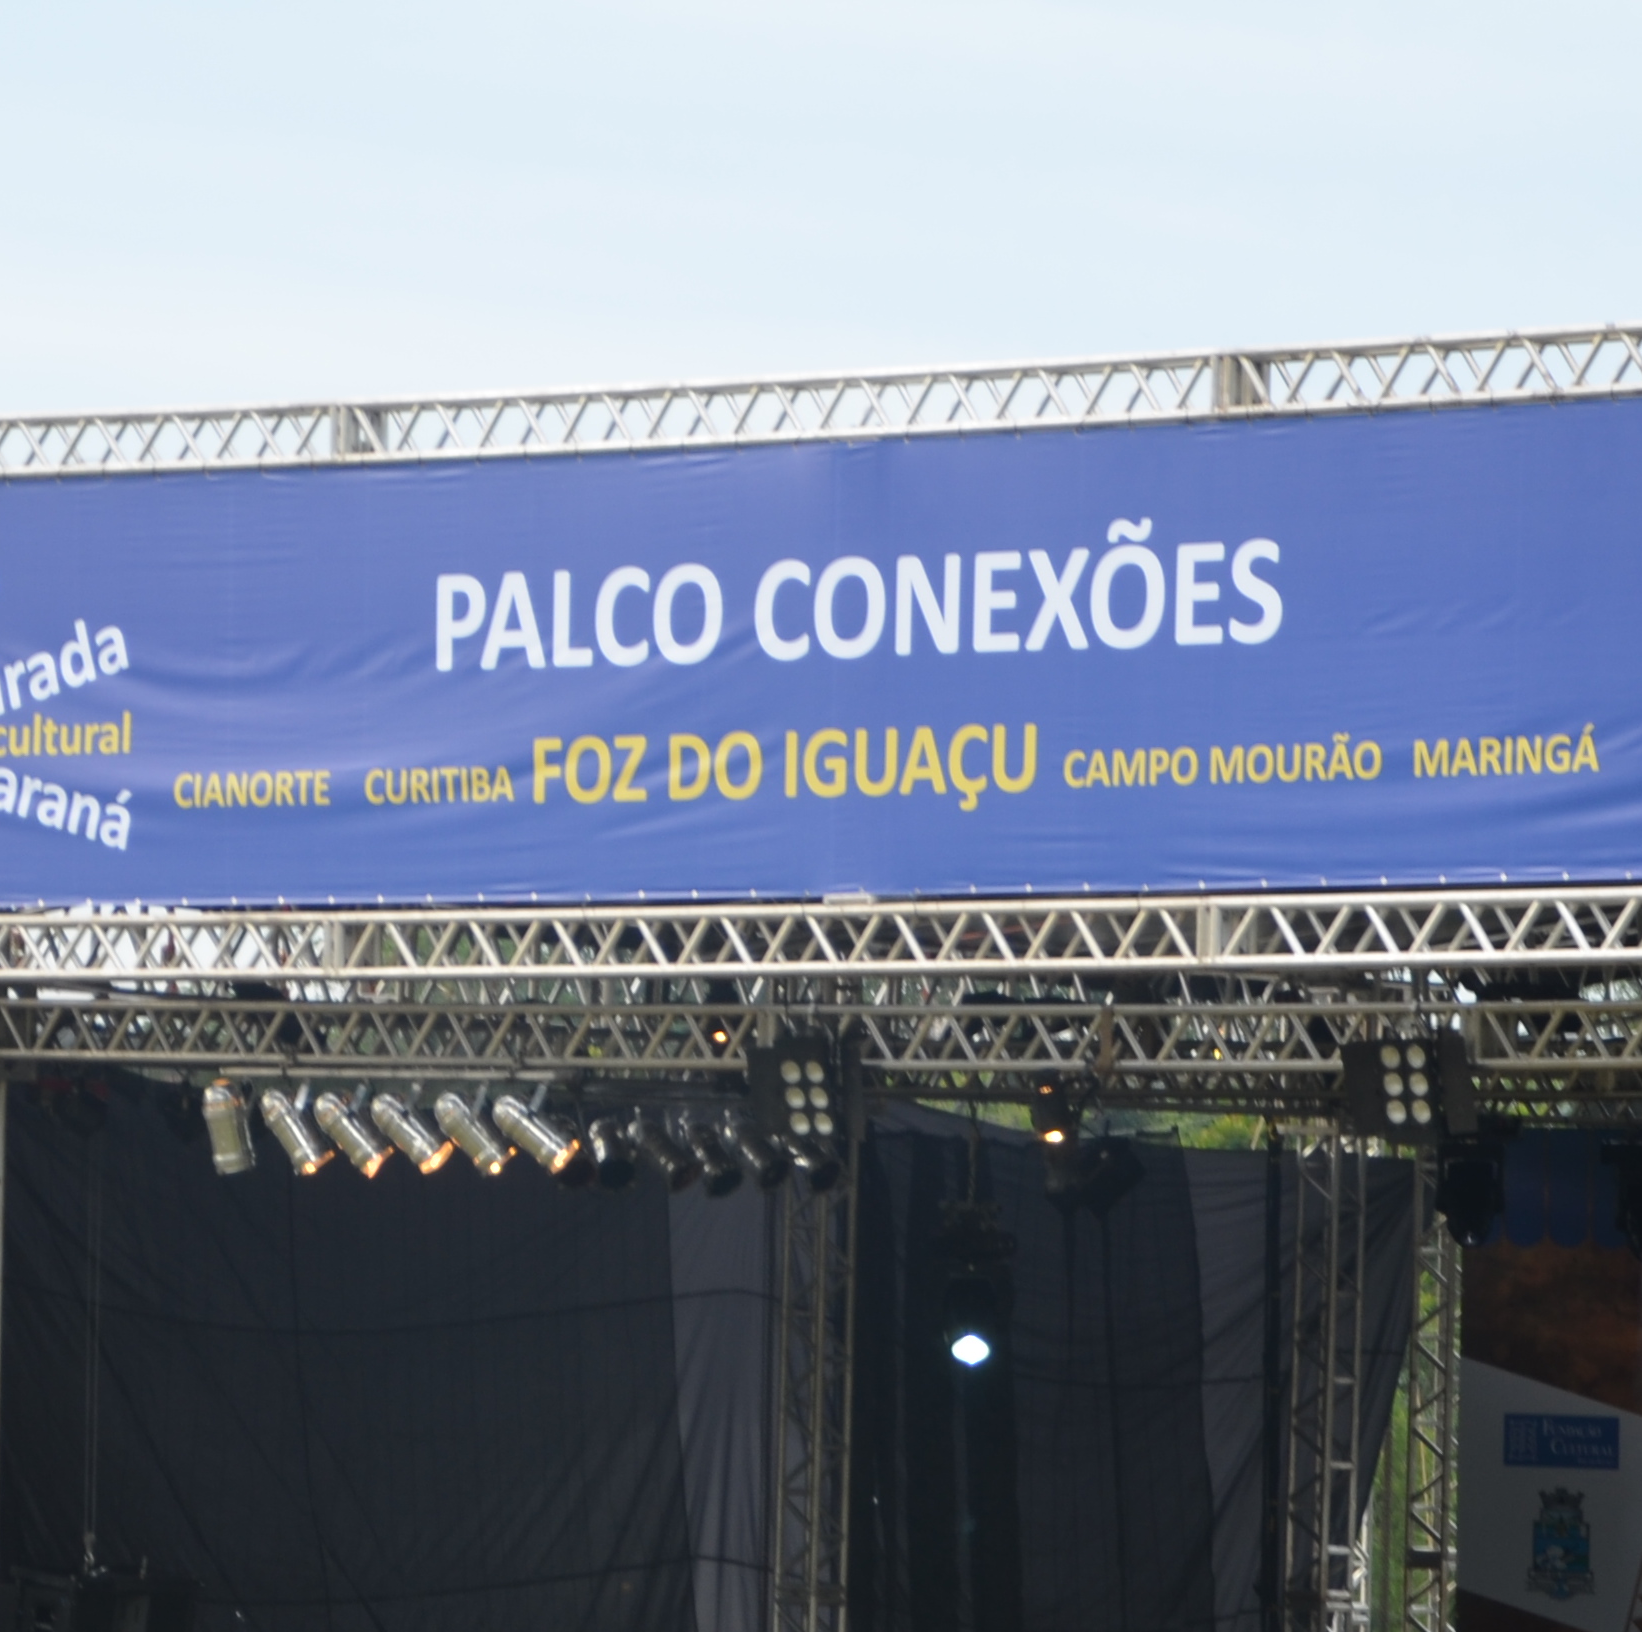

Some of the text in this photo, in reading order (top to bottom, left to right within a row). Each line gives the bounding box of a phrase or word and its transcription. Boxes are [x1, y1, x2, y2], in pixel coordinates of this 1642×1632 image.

[436, 518, 1283, 671] PALCO CONEXÕES
[174, 722, 1600, 811] CIANORTE CURITIBA FOZ DO IGUAÇU CAMPO MOURÃO MARINGÁ
